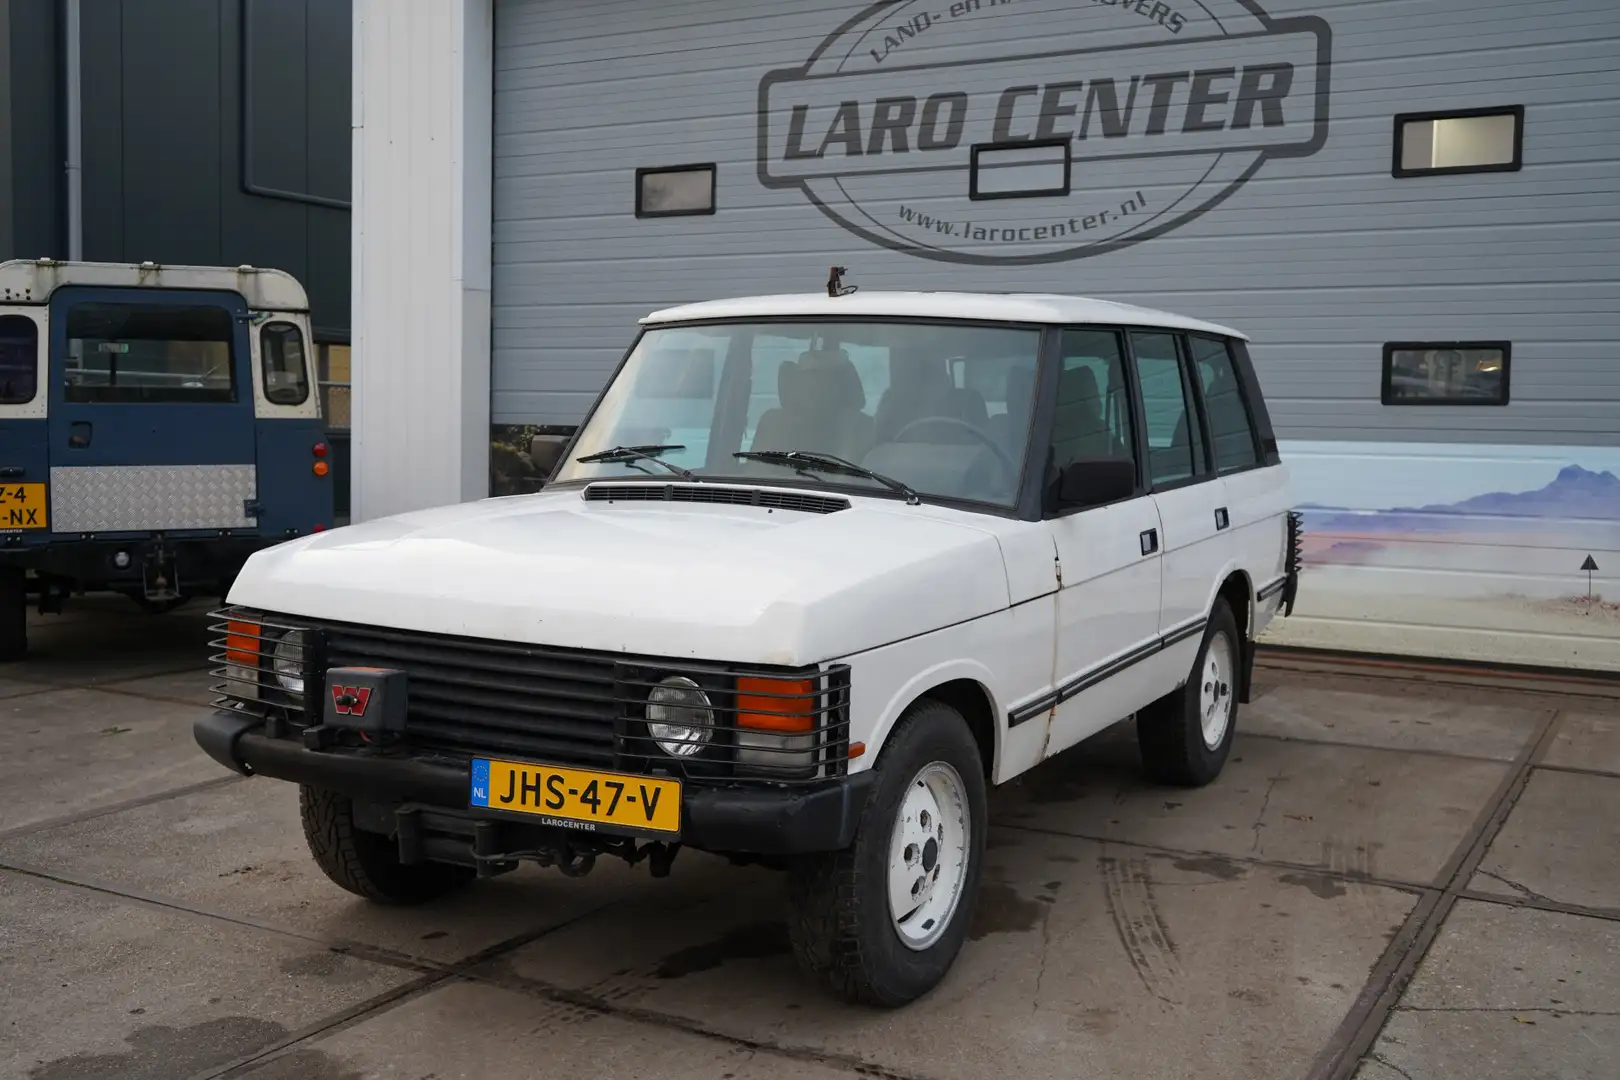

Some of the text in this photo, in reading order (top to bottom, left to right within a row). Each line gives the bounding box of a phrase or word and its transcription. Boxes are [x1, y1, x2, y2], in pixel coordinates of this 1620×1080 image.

[870, 12, 941, 63] LAND-
[950, 0, 981, 18] en
[783, 62, 1294, 161] LARO CENTER
[900, 190, 1147, 242] www.larocenter.nl
[473, 770, 661, 821] NL JHS-47-V
[541, 817, 596, 831] LAROCENTER
